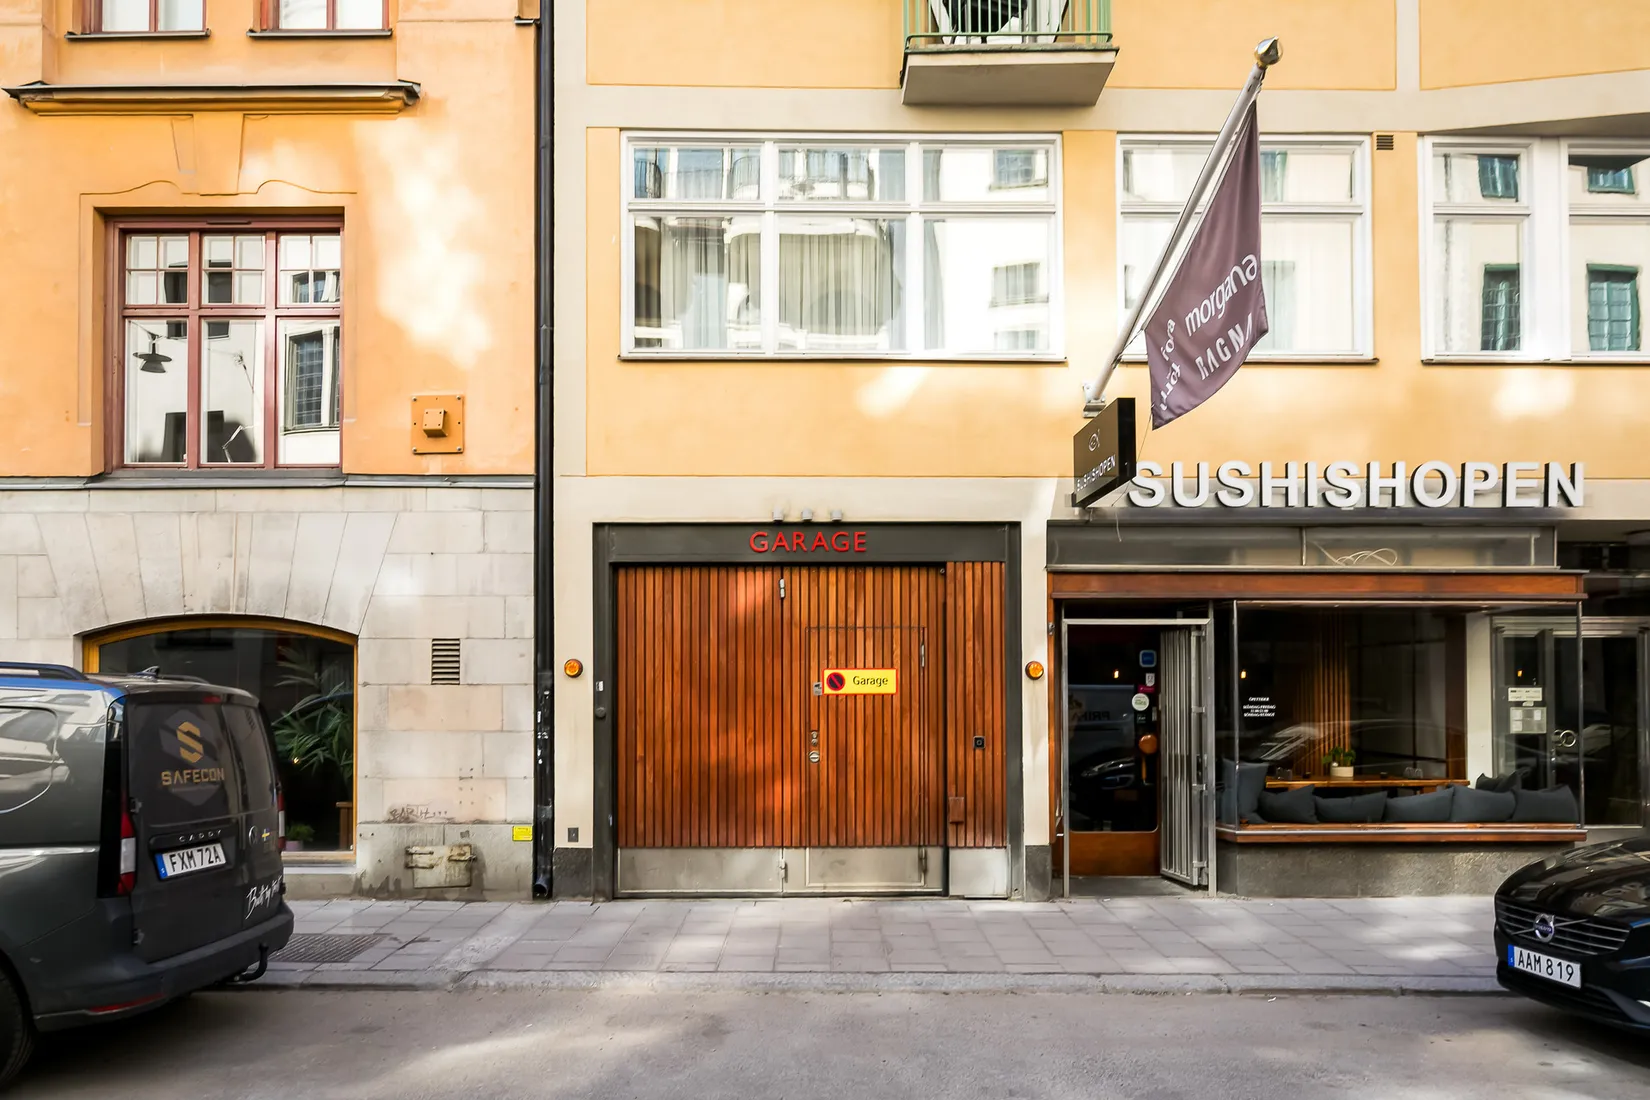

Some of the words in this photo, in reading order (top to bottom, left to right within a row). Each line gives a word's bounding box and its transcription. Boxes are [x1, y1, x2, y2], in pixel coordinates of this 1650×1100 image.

[1185, 254, 1258, 337] morgana
[1127, 460, 1586, 508] SUSHISHOPEN
[749, 531, 867, 553] GARAGE
[852, 675, 889, 687] Garage
[161, 767, 226, 786] SAFECON
[179, 829, 222, 842] CADDY
[168, 849, 197, 872] FXM
[197, 846, 222, 867] 72A
[1518, 950, 1542, 973] AAM
[1546, 959, 1574, 982] 819
